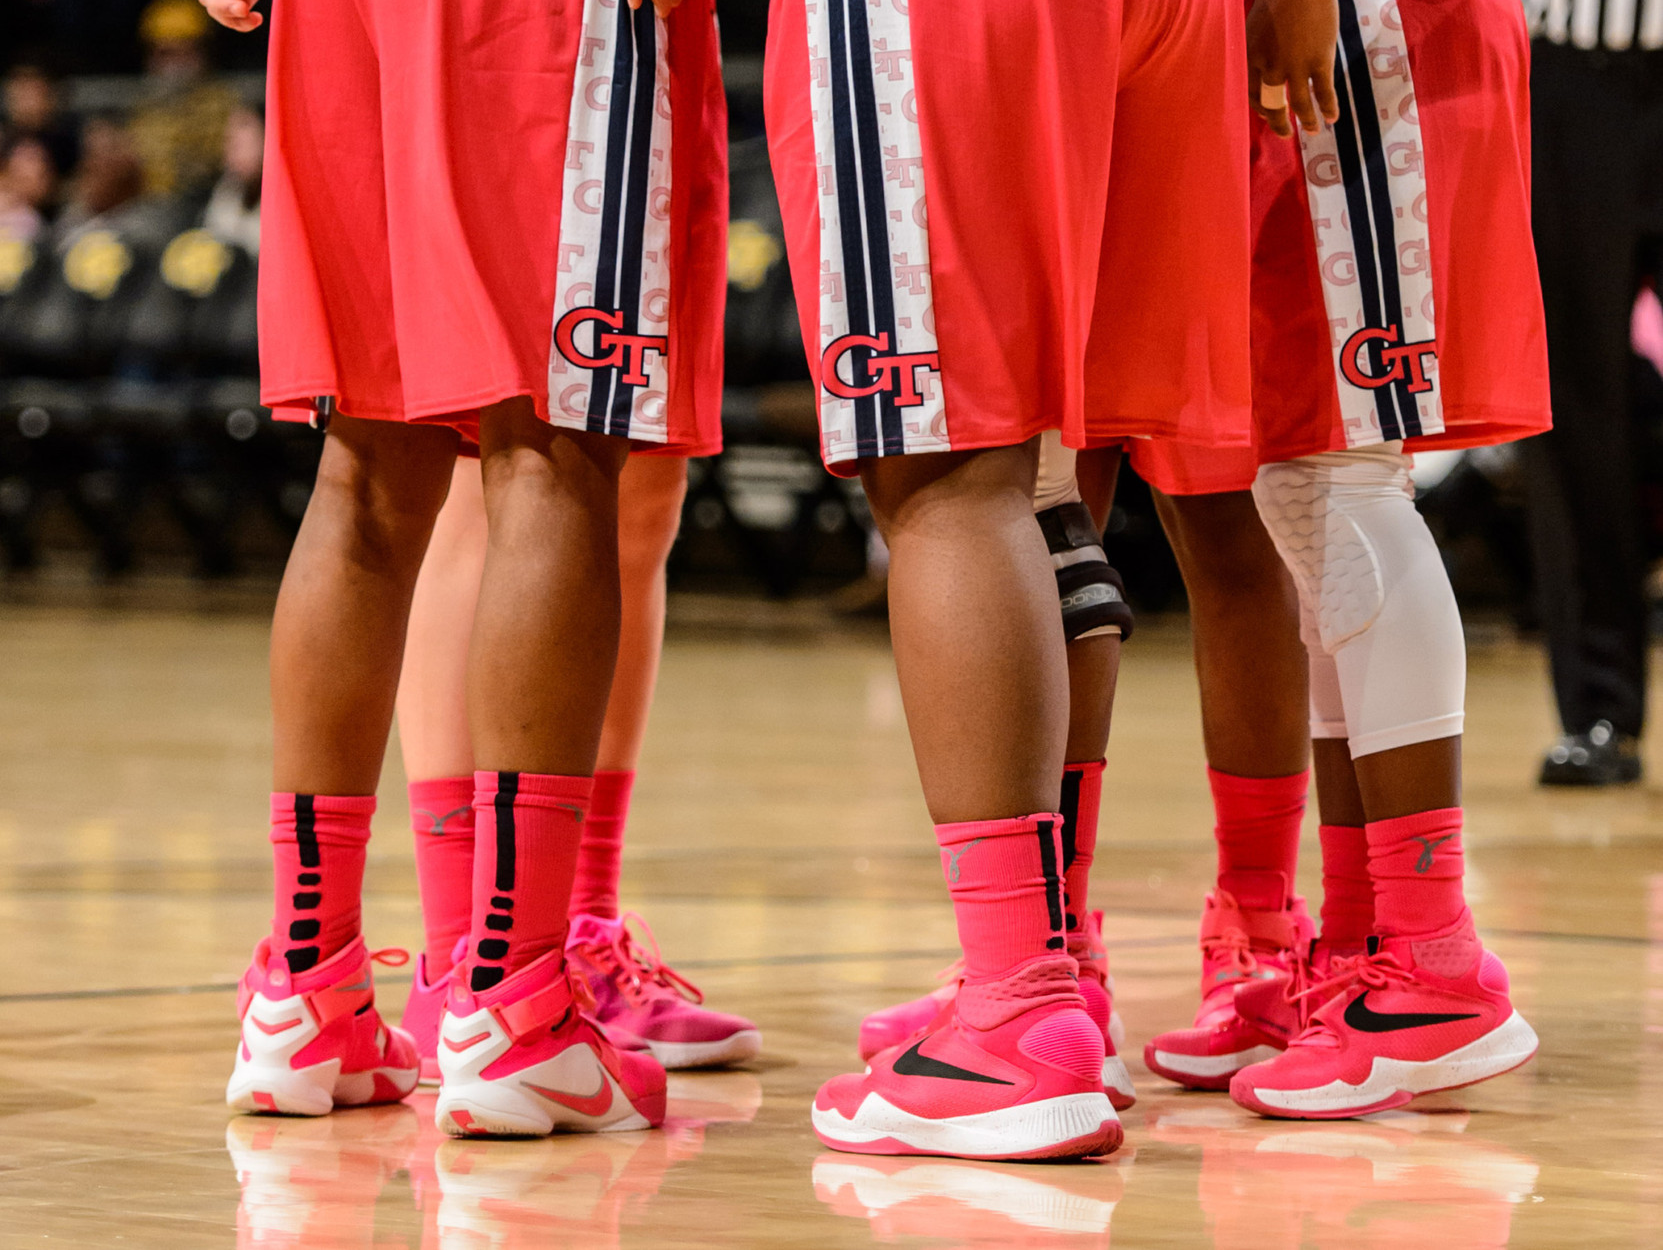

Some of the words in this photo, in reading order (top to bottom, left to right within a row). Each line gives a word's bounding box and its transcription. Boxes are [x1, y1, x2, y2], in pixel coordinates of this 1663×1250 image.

[554, 305, 668, 388] GT
[820, 331, 940, 407] GT
[1339, 323, 1439, 395] GT
